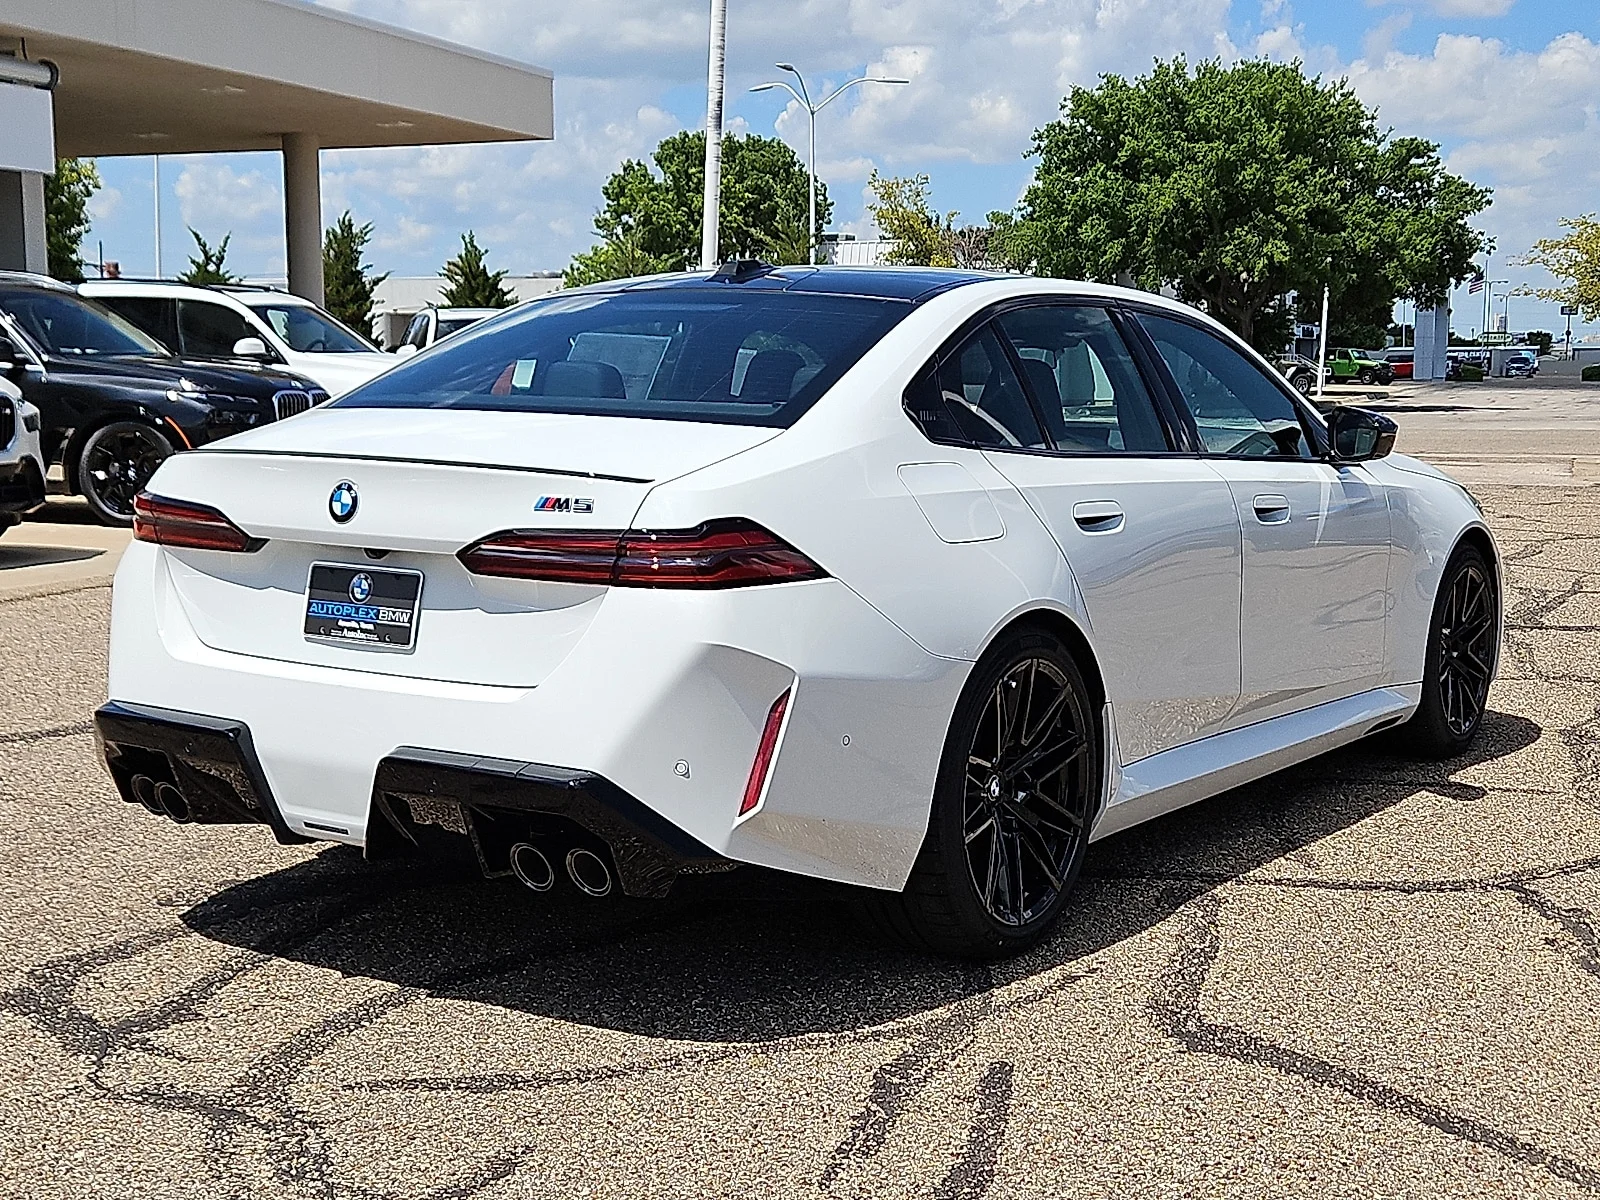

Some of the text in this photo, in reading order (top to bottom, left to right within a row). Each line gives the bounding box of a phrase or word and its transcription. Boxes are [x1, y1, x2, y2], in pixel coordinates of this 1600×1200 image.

[552, 497, 594, 513] M5
[309, 603, 411, 623] AUTOPLEX BMW
